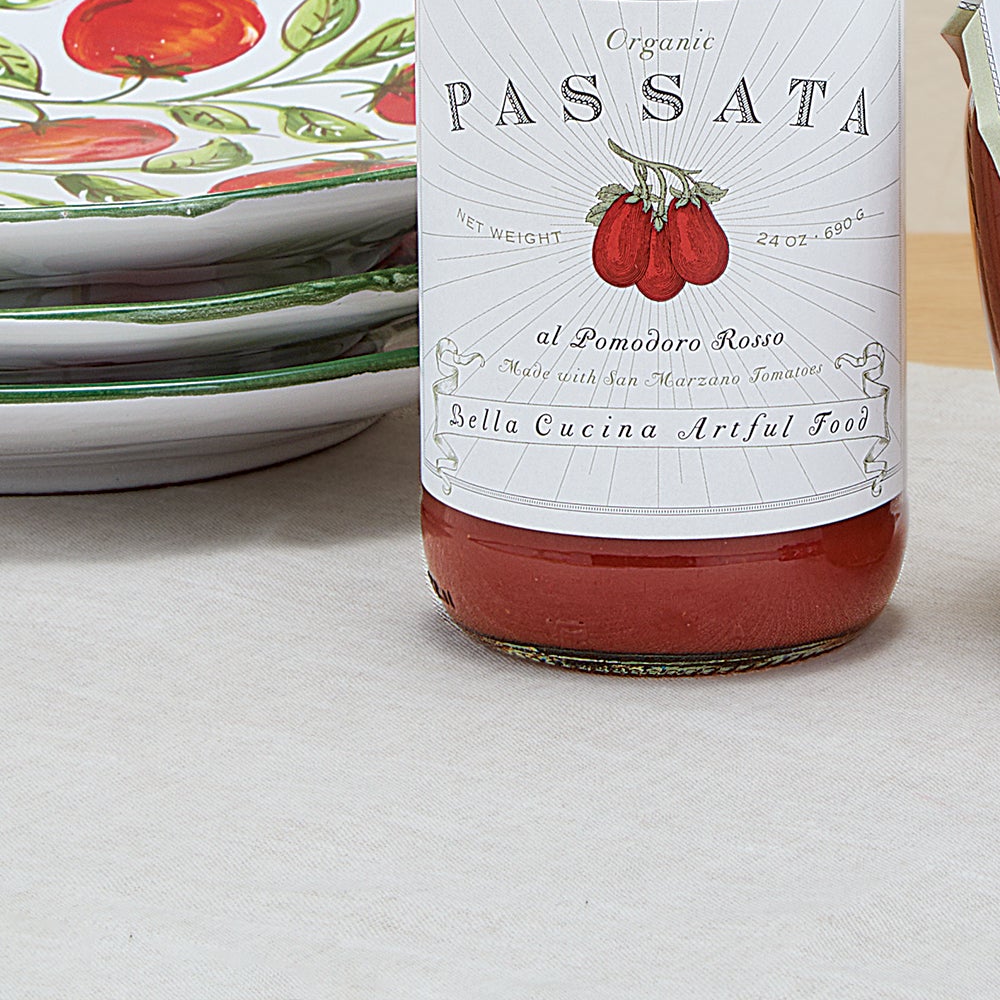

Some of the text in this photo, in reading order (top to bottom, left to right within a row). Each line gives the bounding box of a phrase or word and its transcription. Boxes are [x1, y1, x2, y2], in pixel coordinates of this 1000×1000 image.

[606, 27, 715, 60] Organic
[444, 74, 870, 137] PASSATA
[456, 208, 561, 244] NET WEIGHT
[756, 232, 779, 247] 24
[785, 234, 808, 248] OZ
[536, 326, 785, 352] al Pomodoro Rosso
[498, 358, 823, 387] Made with San Marzano Tomatoes
[450, 403, 870, 443] Bella Cucina Artful Food
